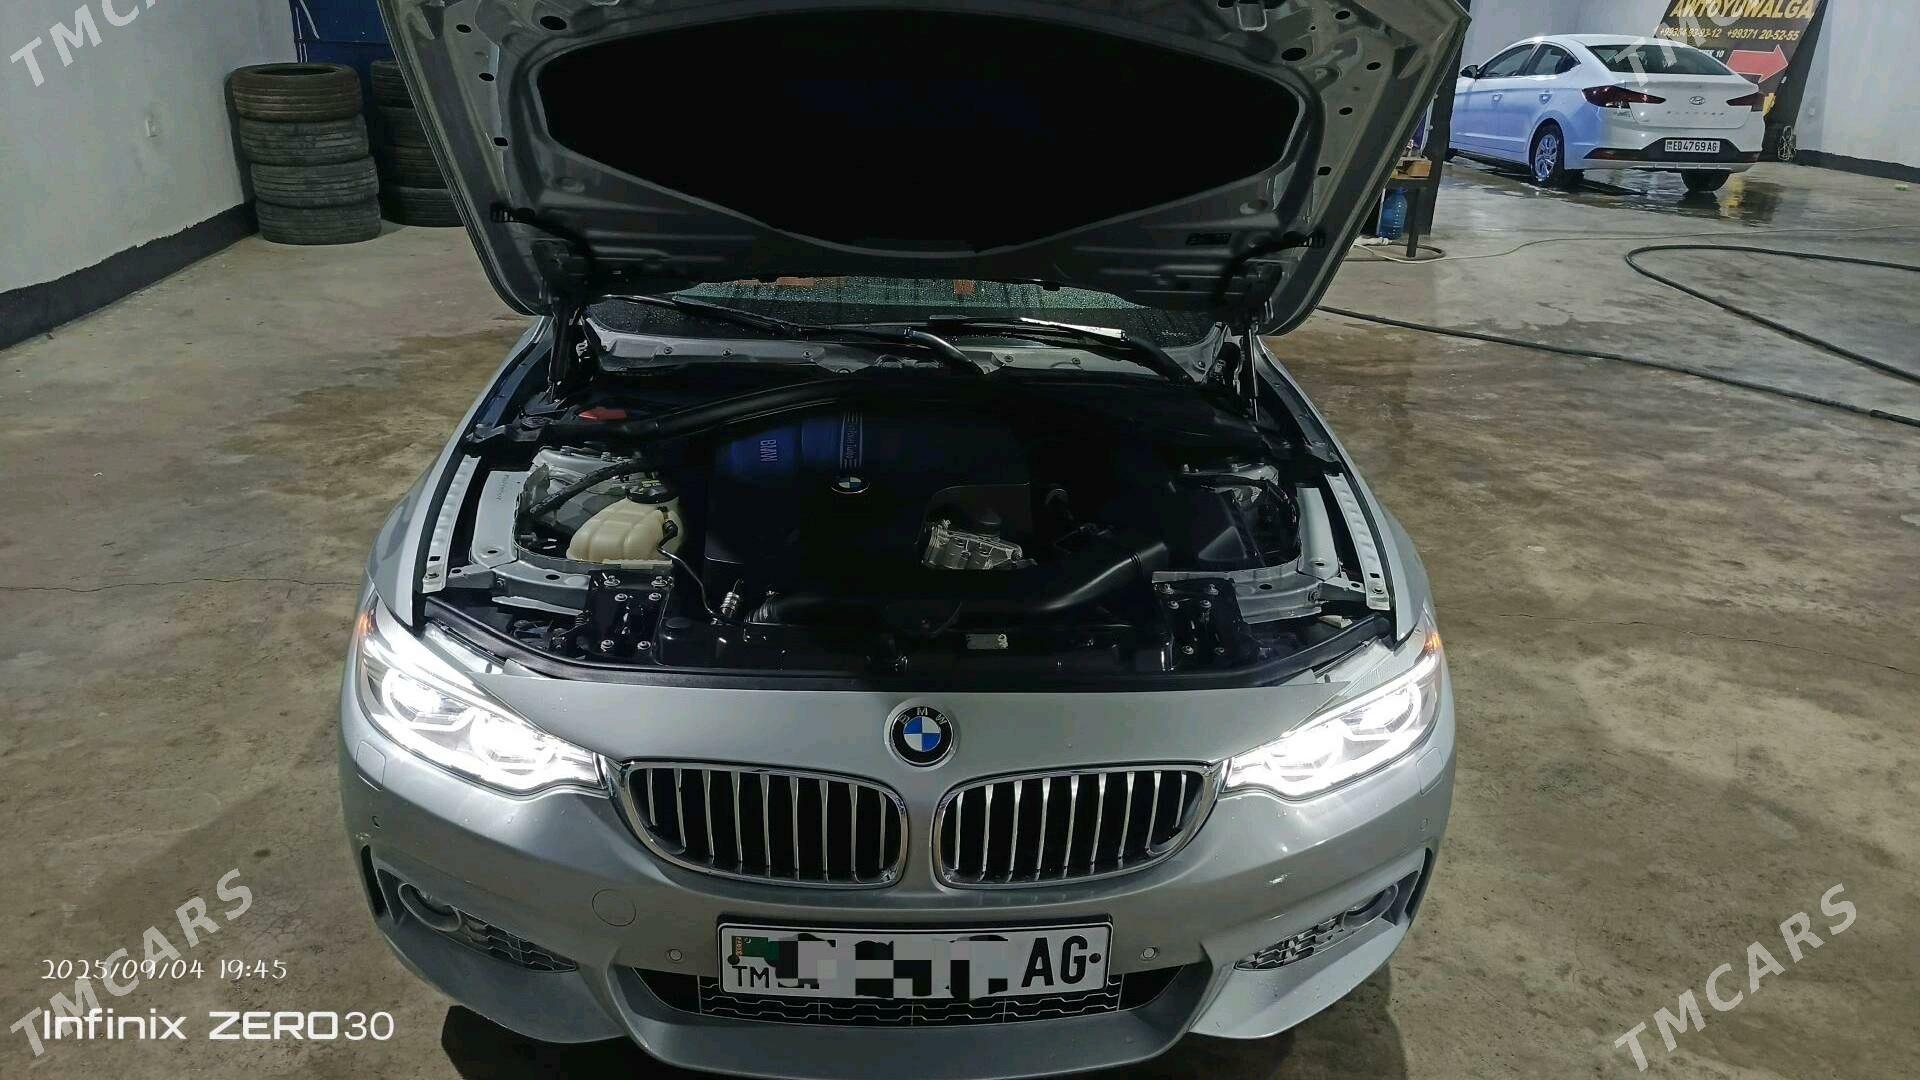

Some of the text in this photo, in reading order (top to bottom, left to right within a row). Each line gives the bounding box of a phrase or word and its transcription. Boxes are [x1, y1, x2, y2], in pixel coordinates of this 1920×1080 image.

[760, 439, 778, 462] BMW
[899, 707, 947, 725] BMW
[731, 965, 770, 989] TM
[1021, 935, 1088, 988] AG
